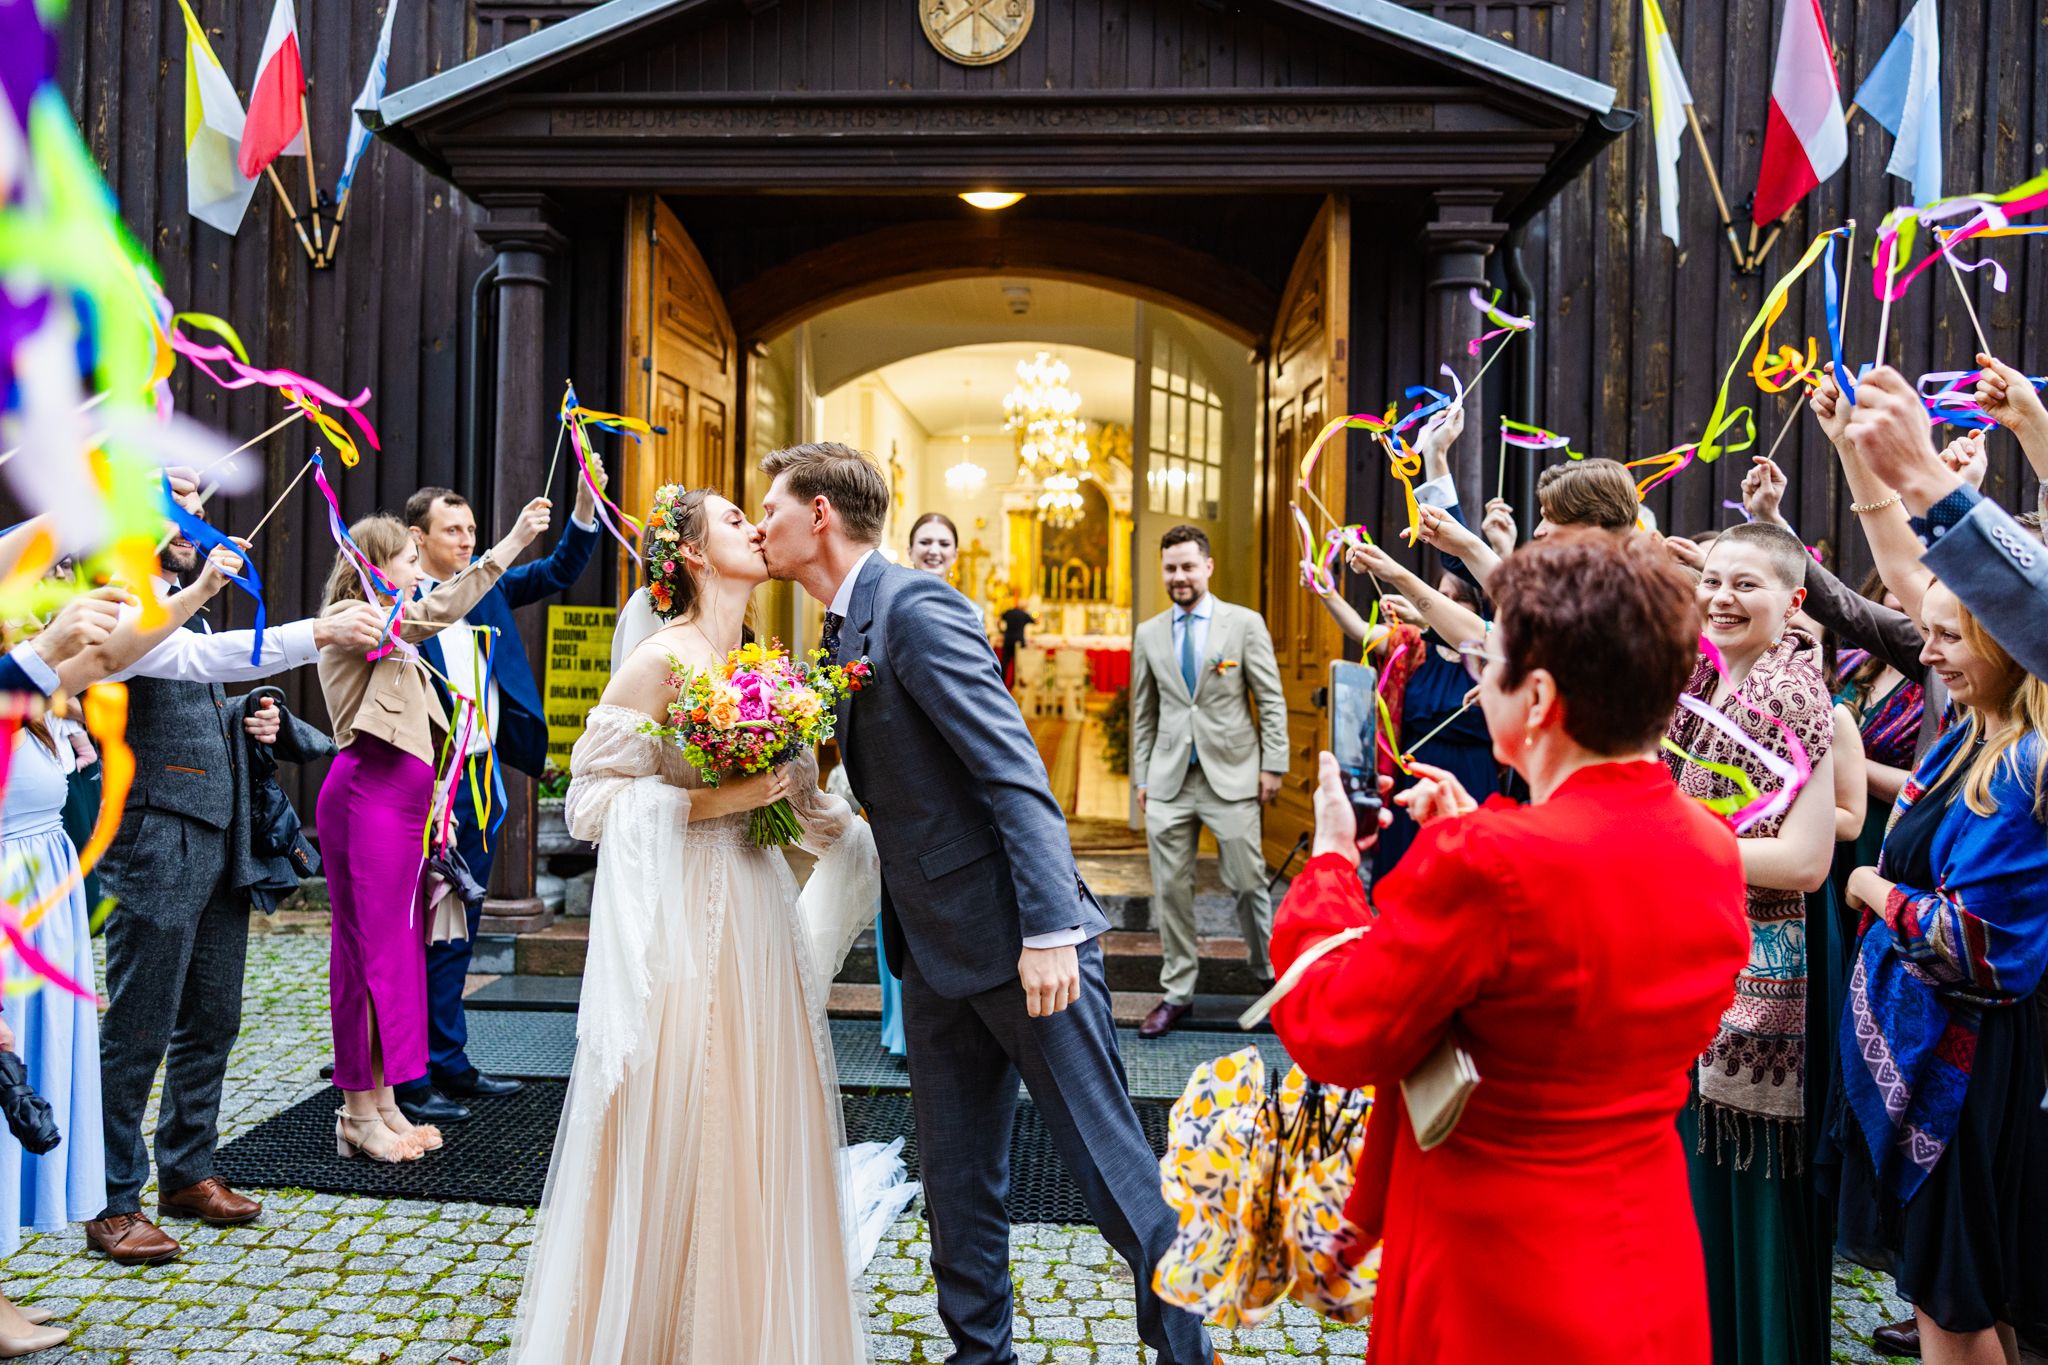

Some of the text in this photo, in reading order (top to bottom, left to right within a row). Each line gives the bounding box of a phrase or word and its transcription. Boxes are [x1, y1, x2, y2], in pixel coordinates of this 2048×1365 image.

[571, 110, 678, 128] TEMPLUM
[793, 110, 876, 127] MATRIS
[564, 612, 599, 627] TABLICA
[553, 644, 578, 656] ADRES
[552, 658, 572, 670] DATA
[580, 659, 592, 671] NR
[550, 685, 578, 698] ORGAN
